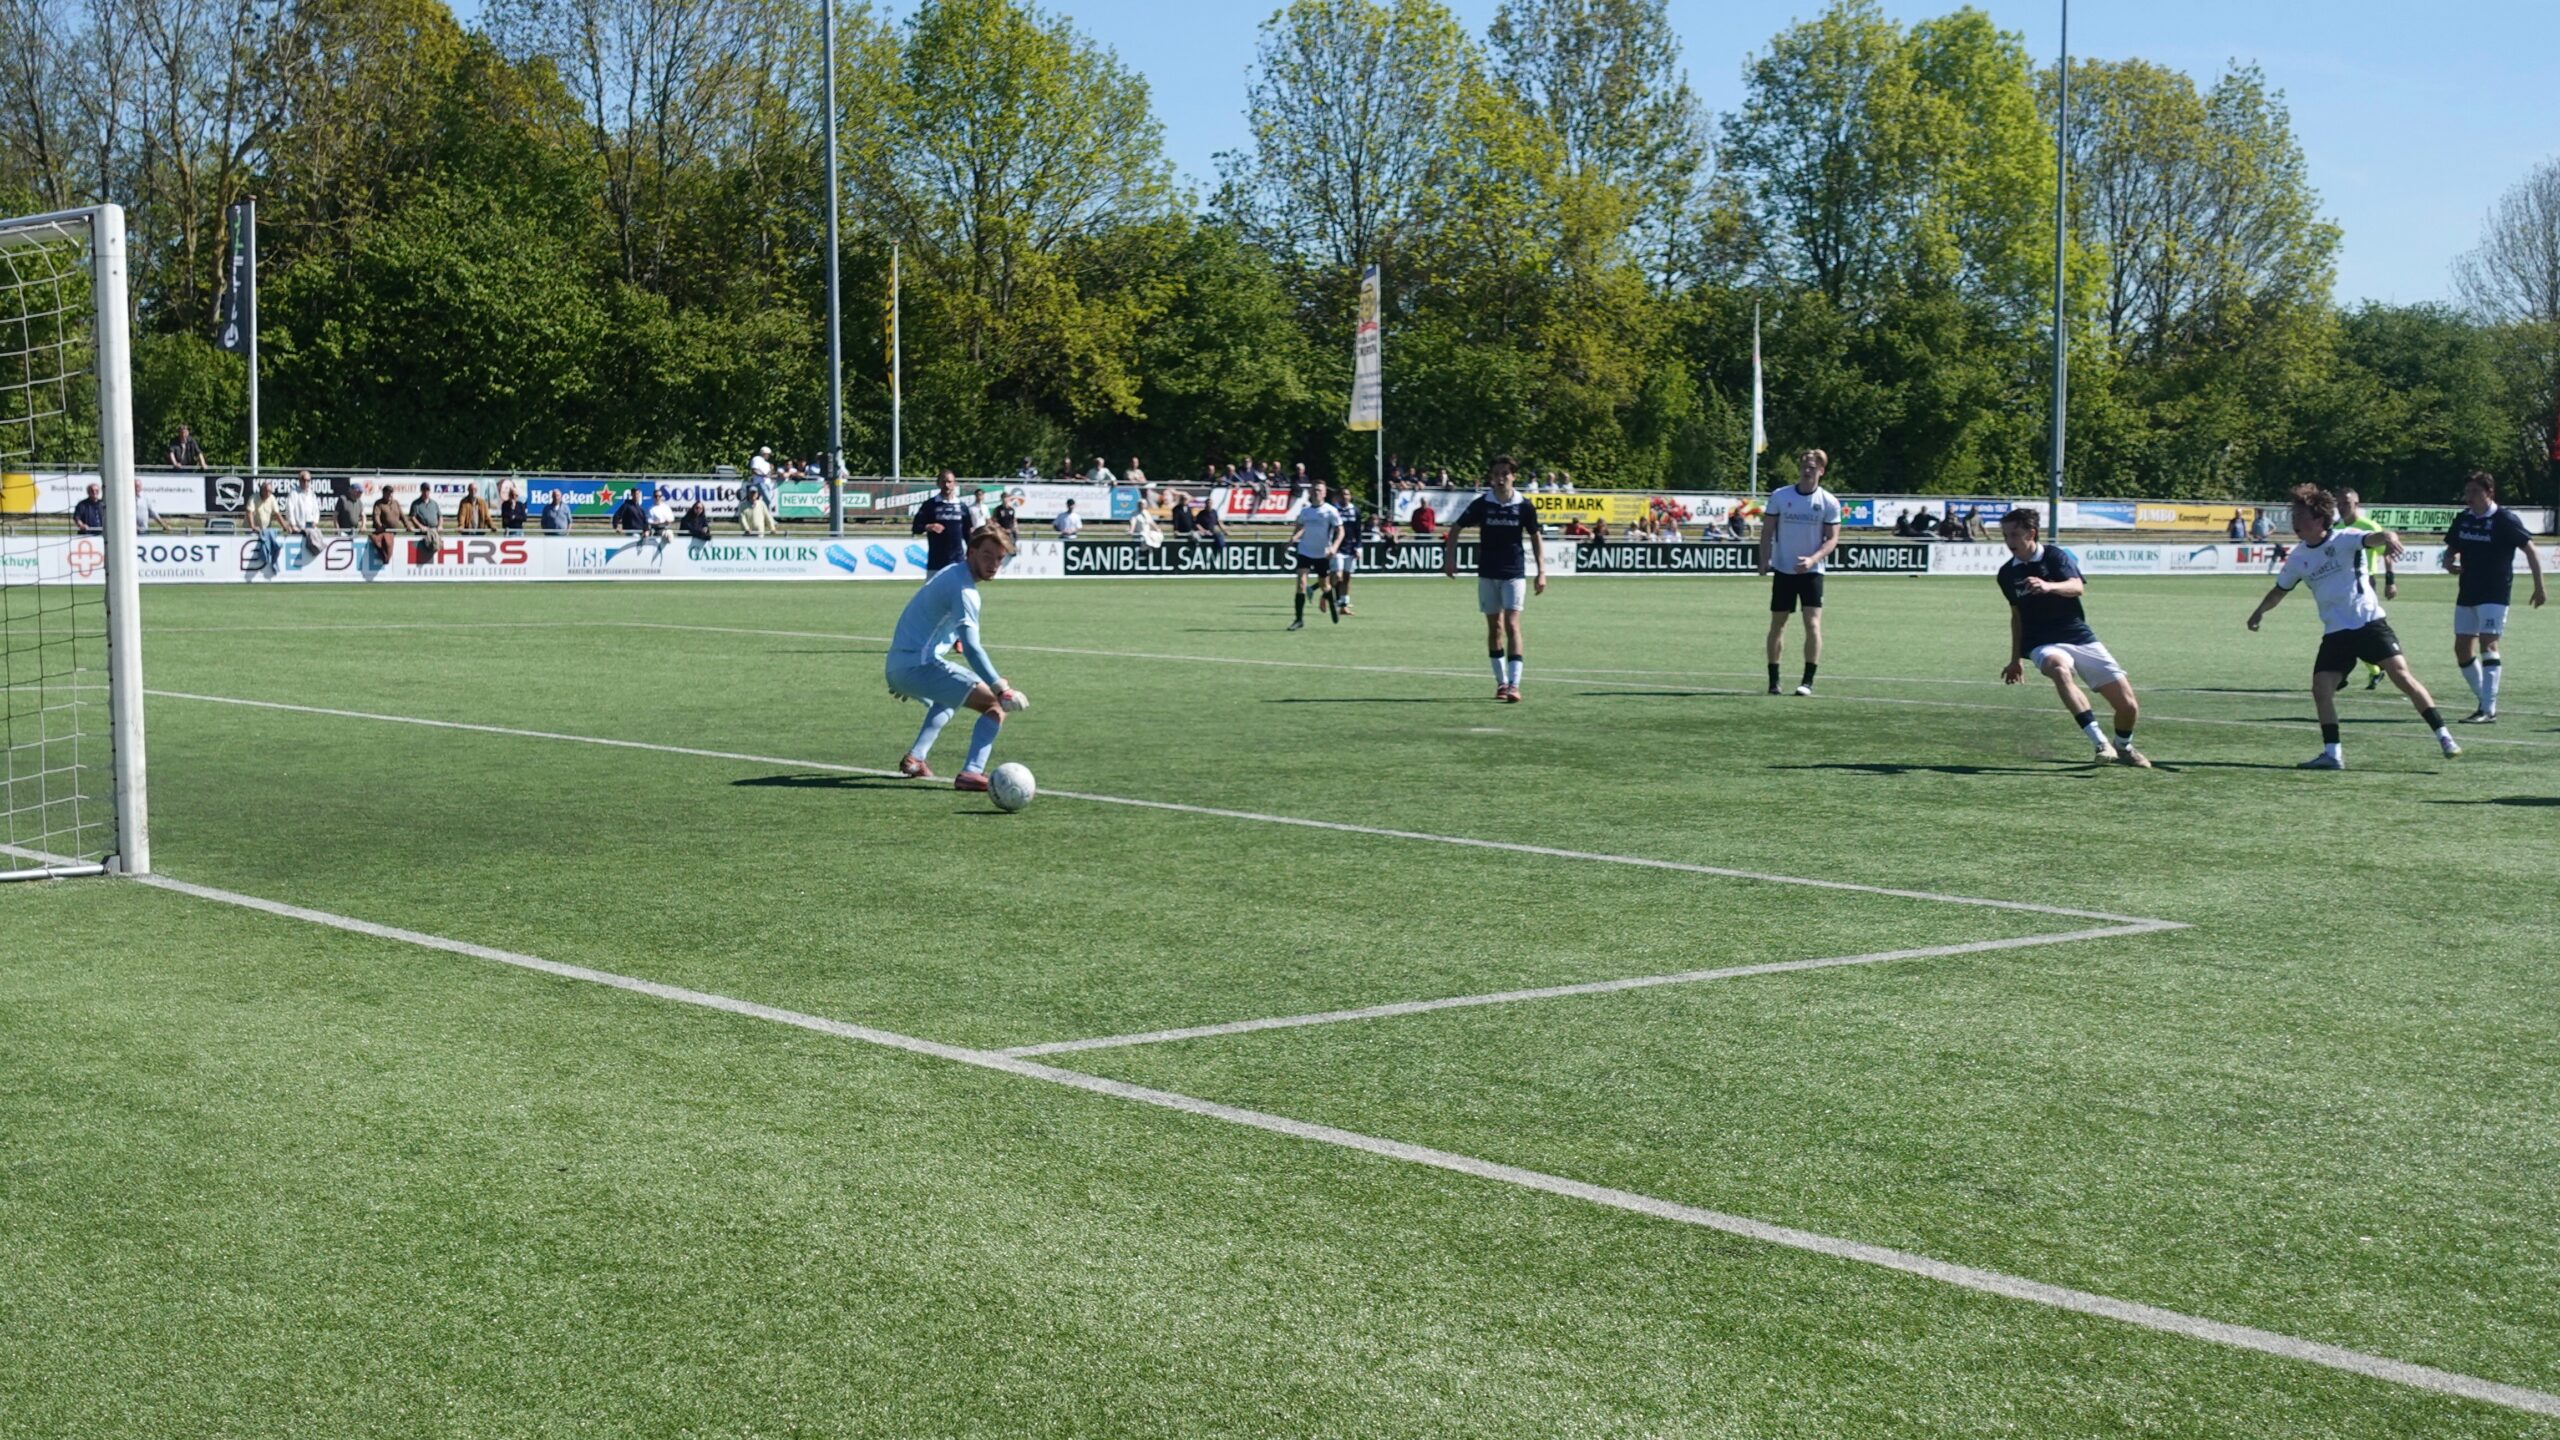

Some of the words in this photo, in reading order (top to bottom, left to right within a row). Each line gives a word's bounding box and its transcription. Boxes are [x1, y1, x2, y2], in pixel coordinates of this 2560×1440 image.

[531, 490, 595, 504] Heieken
[784, 495, 807, 504] NEW
[809, 495, 831, 504] YOR
[1536, 497, 1562, 510] DER
[1566, 497, 1604, 511] MARK
[1696, 506, 1726, 516] GRAAF
[2138, 508, 2176, 522] JUMBO
[2371, 510, 2391, 522] PEET
[2395, 510, 2412, 523] THE
[437, 540, 528, 565] HRS
[688, 546, 757, 561] GARDEN
[763, 546, 818, 561] TOURS
[1066, 546, 1174, 571] SANIBELL
[1178, 546, 1282, 571] SANIBELL
[1385, 546, 1479, 569] SANIBLL
[1578, 547, 1669, 569] SANIBELL
[1670, 547, 1758, 569] SANIBELL
[1848, 548, 1927, 569] SANIBELL
[1951, 546, 2006, 557] LANKA
[2086, 550, 2126, 561] GARDEN
[2128, 550, 2159, 561] TOURS
[138, 566, 205, 577] ccountants
[450, 568, 478, 576] RENTAL
[489, 568, 527, 576] SERVICES
